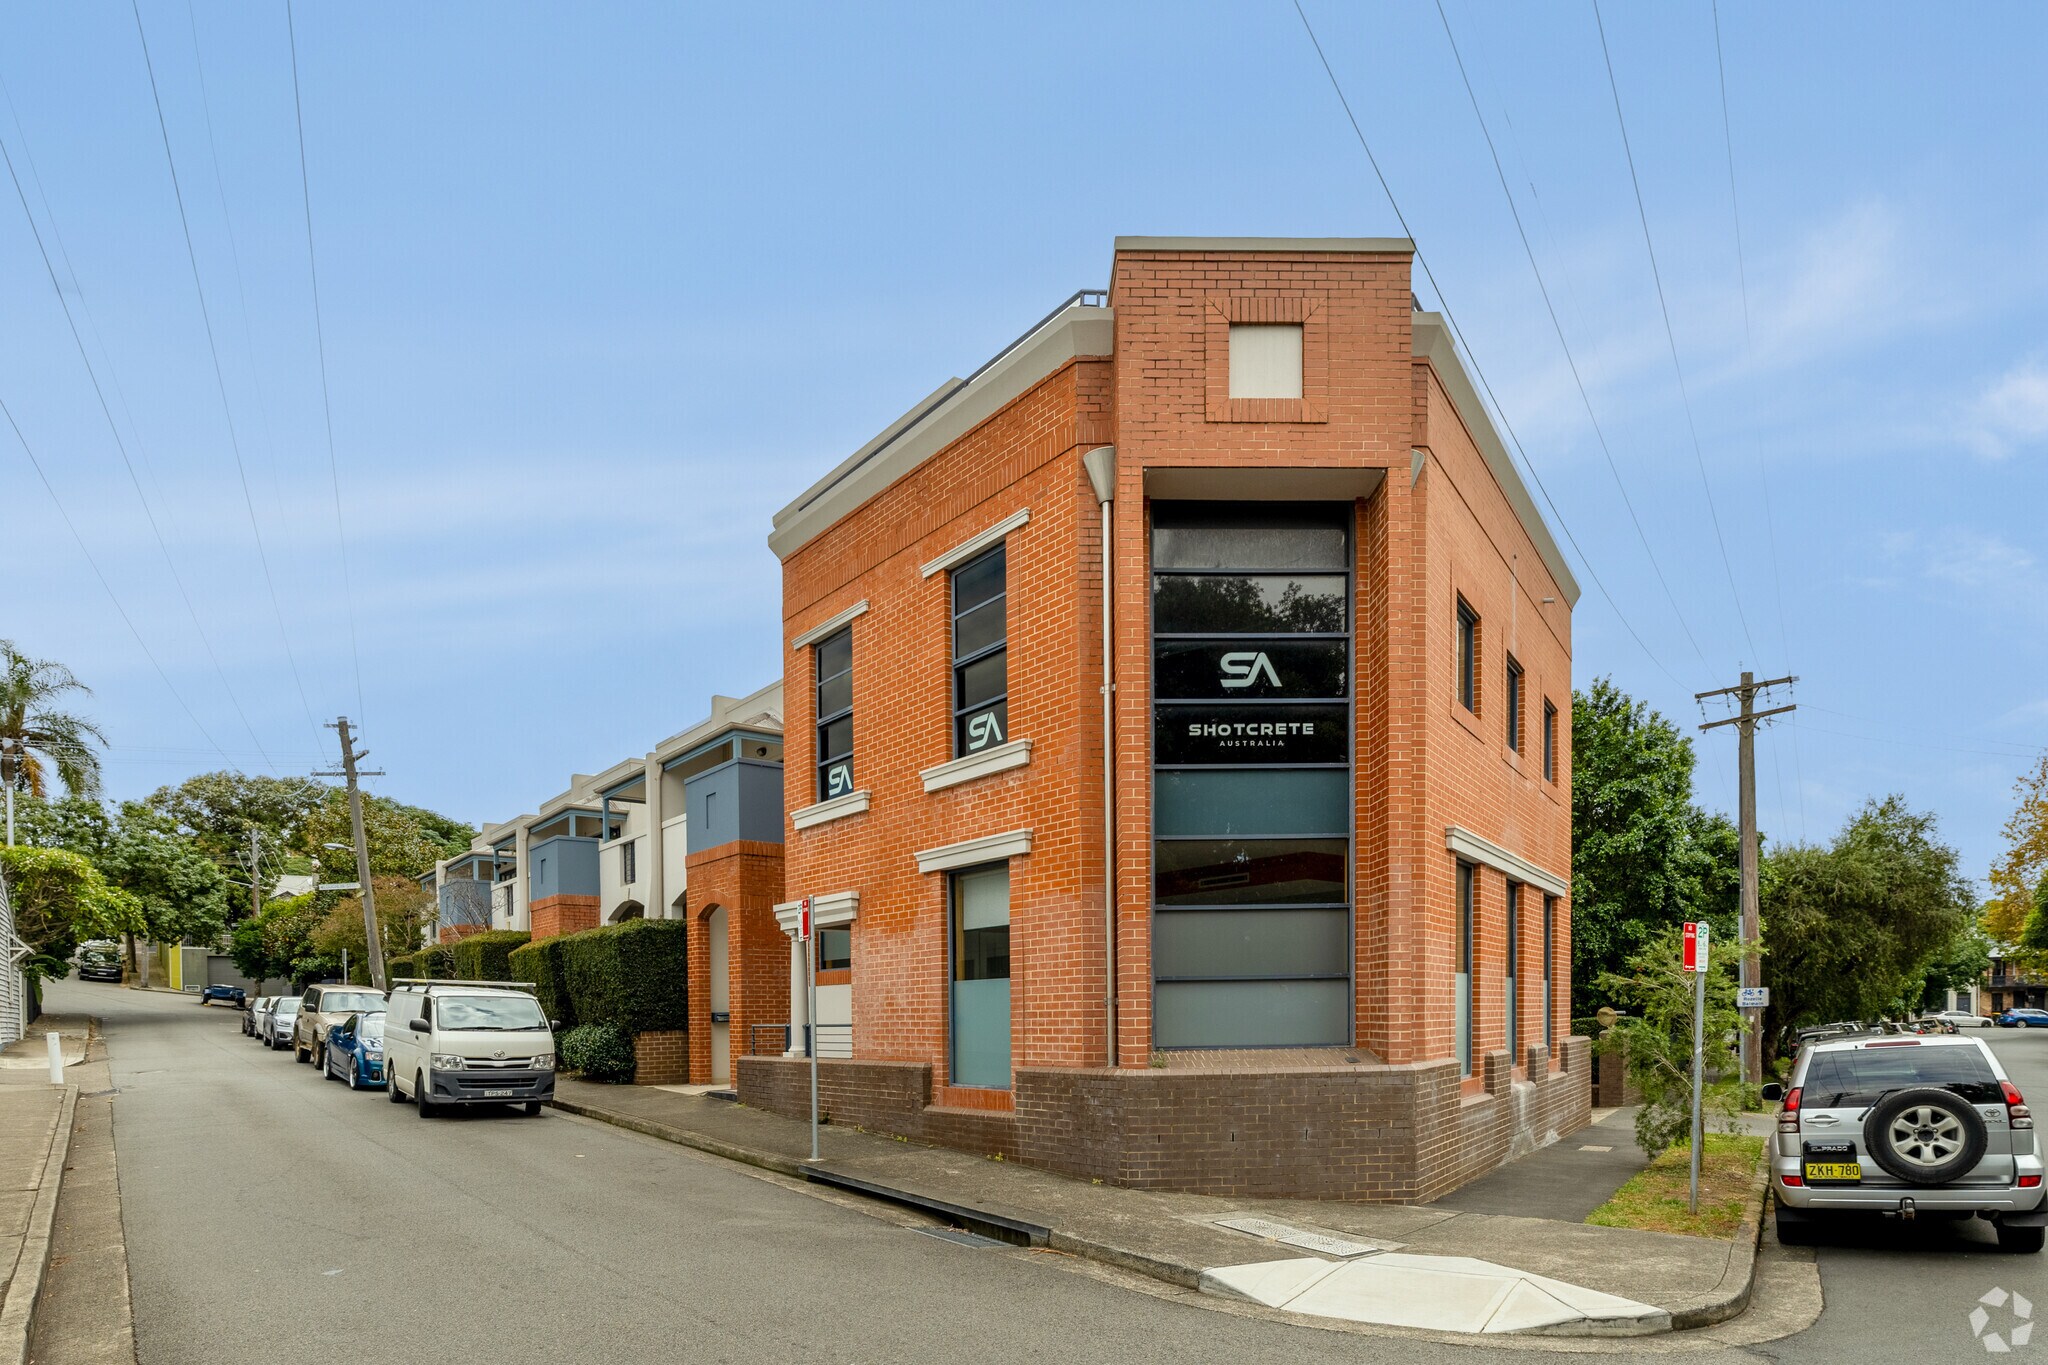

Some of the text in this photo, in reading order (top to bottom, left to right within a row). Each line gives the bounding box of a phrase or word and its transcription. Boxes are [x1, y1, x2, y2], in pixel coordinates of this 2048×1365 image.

[1220, 652, 1283, 688] SA
[969, 711, 1003, 751] SA
[1189, 723, 1314, 737] SHOTCRETE
[828, 764, 853, 796] SA
[1698, 926, 1708, 938] 2P
[1809, 1165, 1859, 1176] ZKH-780
